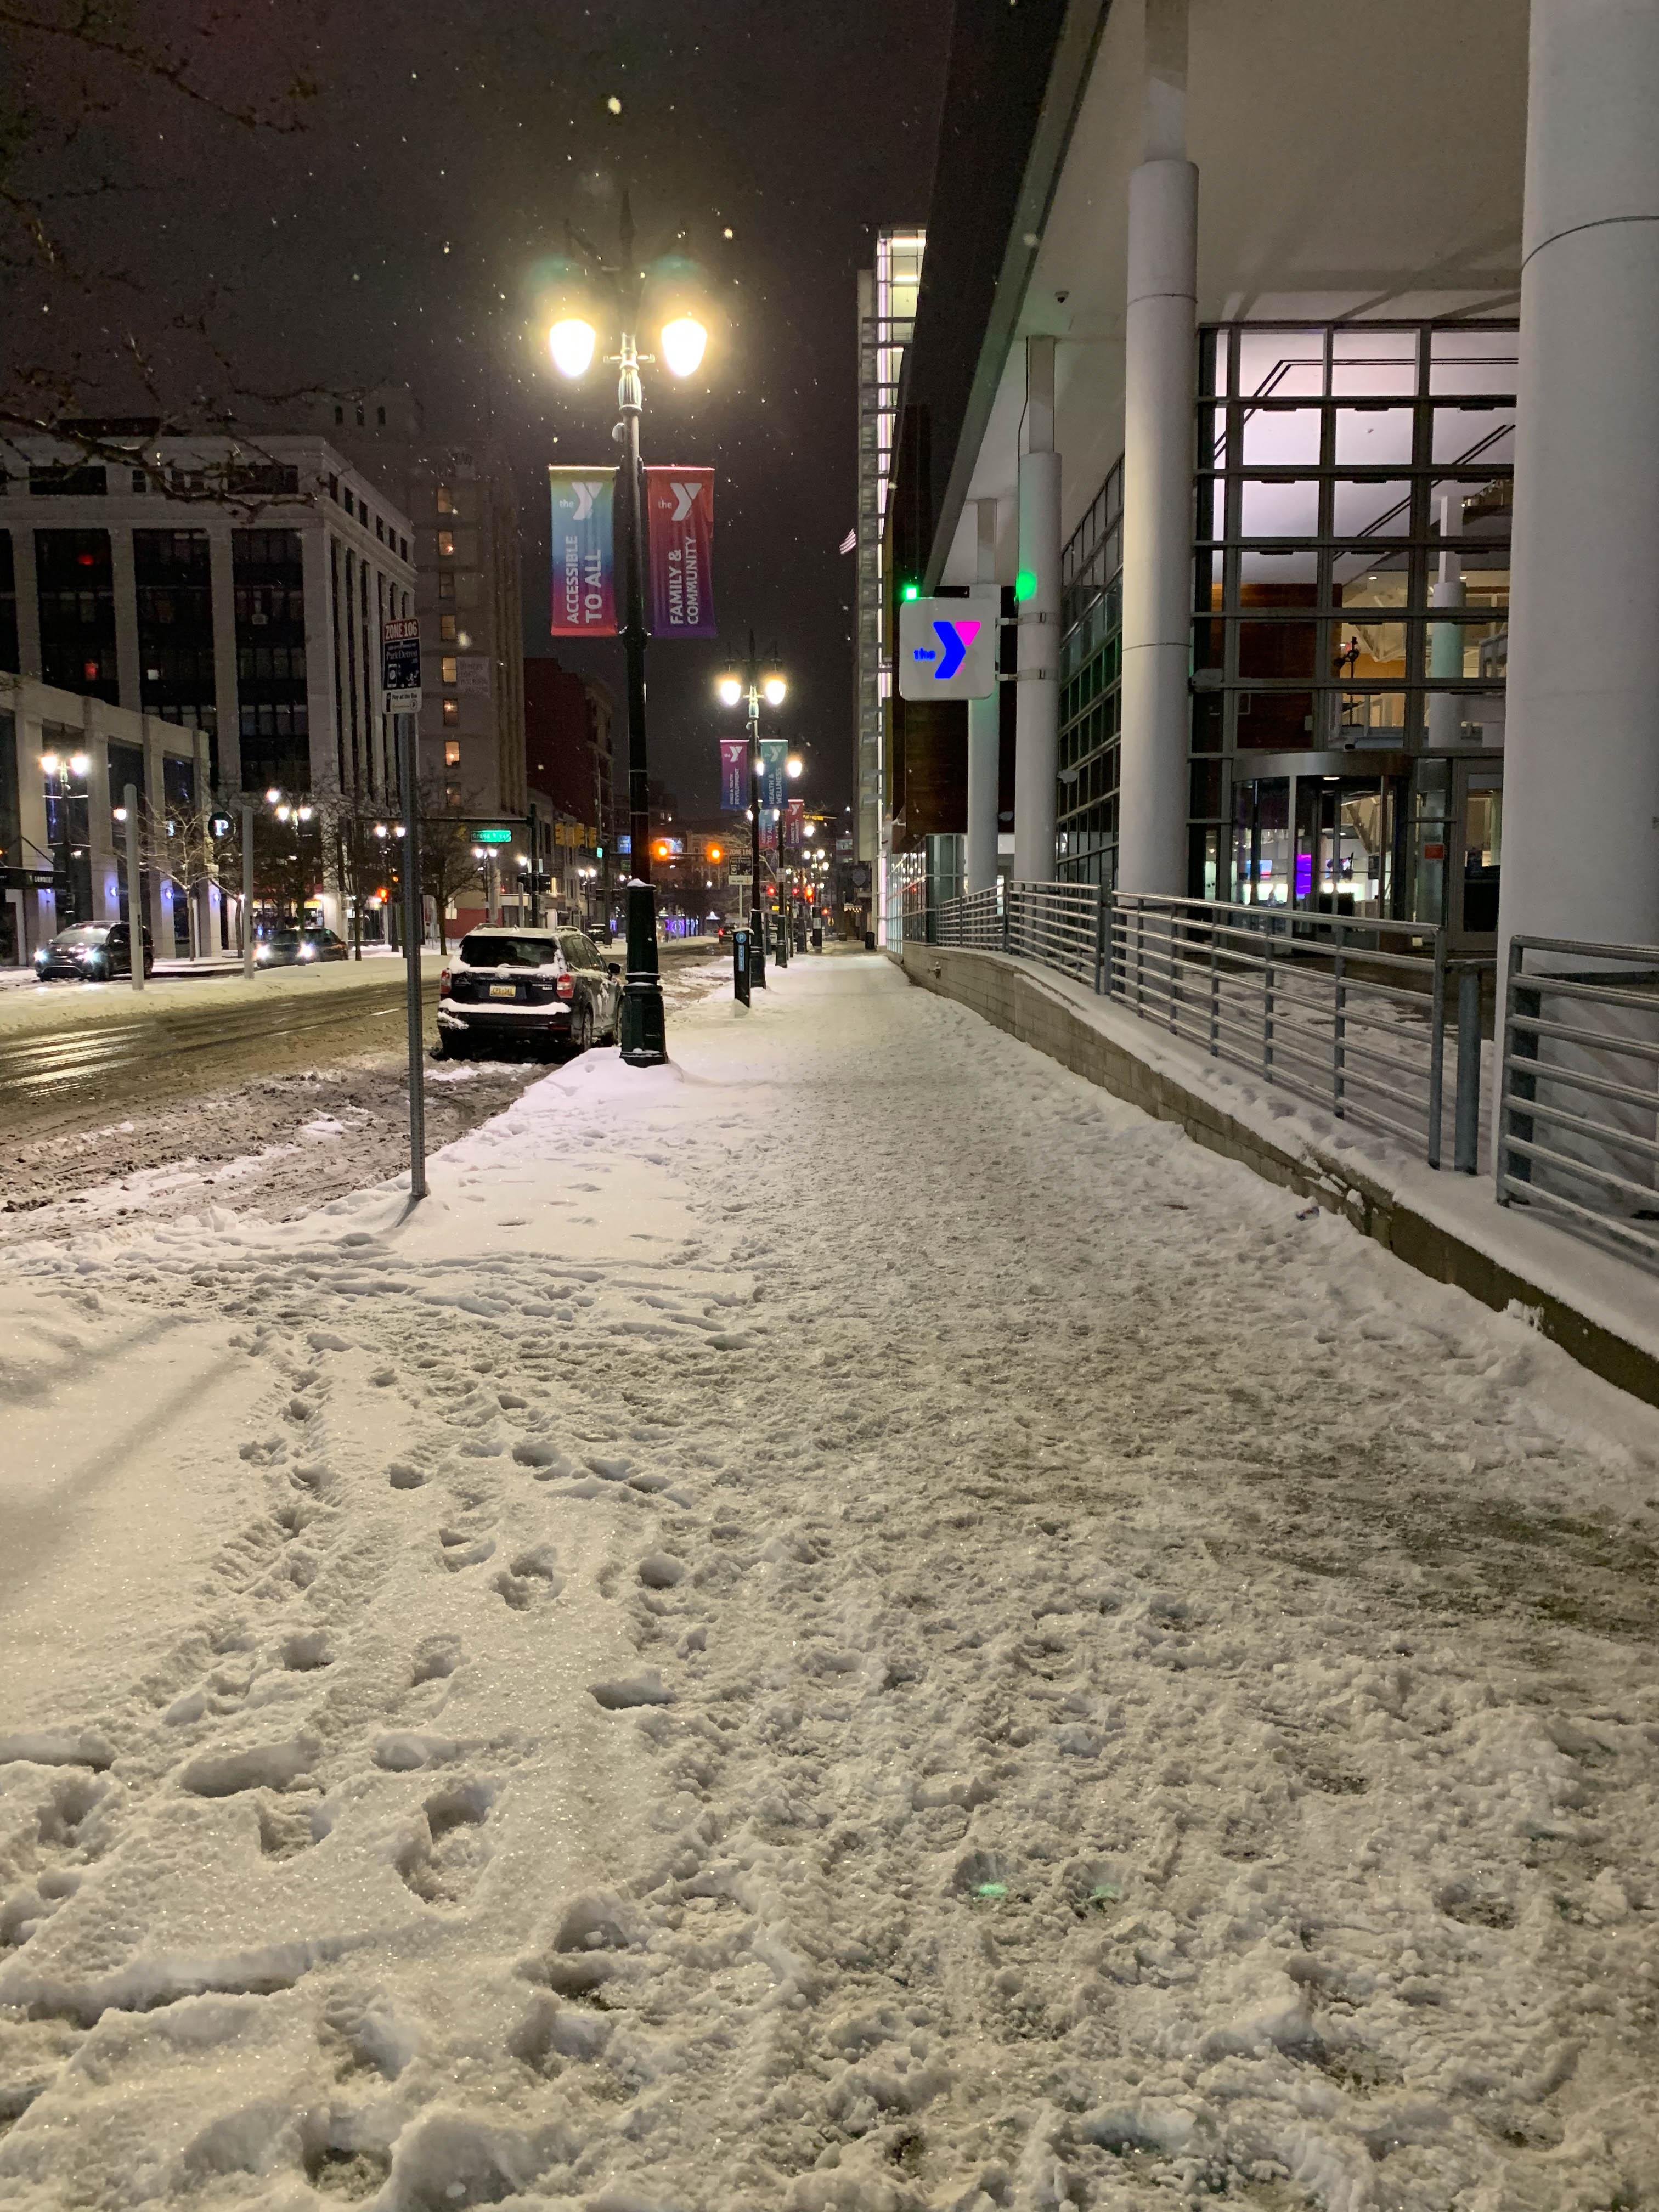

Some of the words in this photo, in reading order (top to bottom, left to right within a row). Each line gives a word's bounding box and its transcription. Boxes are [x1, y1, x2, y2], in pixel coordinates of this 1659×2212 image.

[559, 499, 574, 509] the
[658, 499, 673, 509] the
[669, 550, 682, 561] &
[585, 549, 602, 588] ALL
[566, 535, 579, 624] ACCESSIBLE
[685, 537, 698, 624] COMMUNITY
[669, 566, 684, 625] FAMILY
[585, 594, 602, 624] TO
[385, 623, 403, 640] ZONE
[404, 622, 417, 637] 106
[913, 647, 936, 661] the
[214, 820, 229, 836] P
